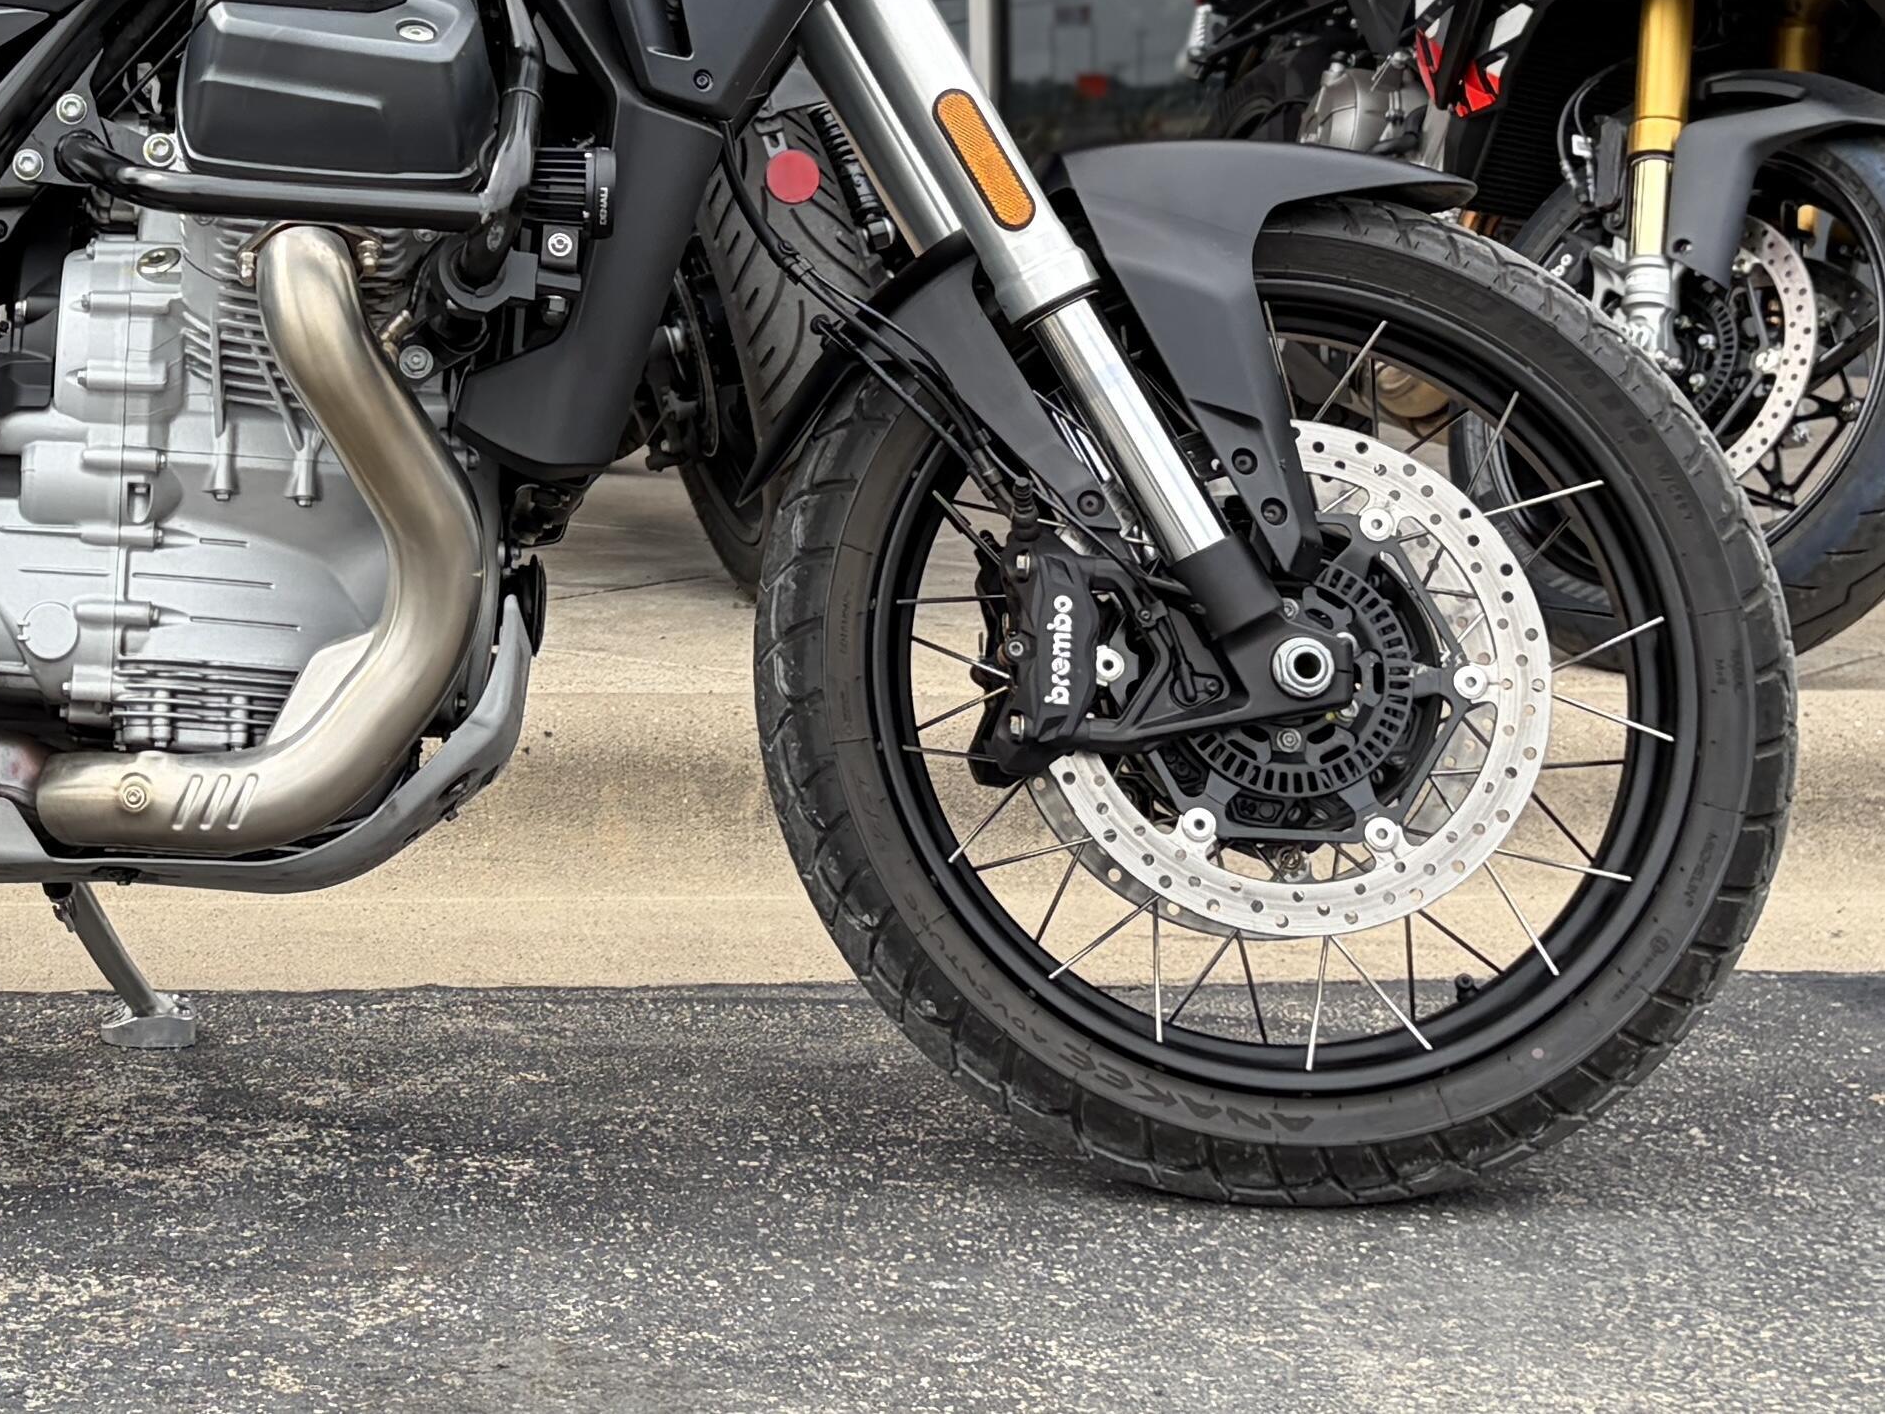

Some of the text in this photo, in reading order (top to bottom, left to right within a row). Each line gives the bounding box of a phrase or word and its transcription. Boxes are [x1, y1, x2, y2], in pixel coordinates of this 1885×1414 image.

[1044, 594, 1073, 705] brembo
[905, 891, 1315, 1133] ANAKEE ADVENTURE
